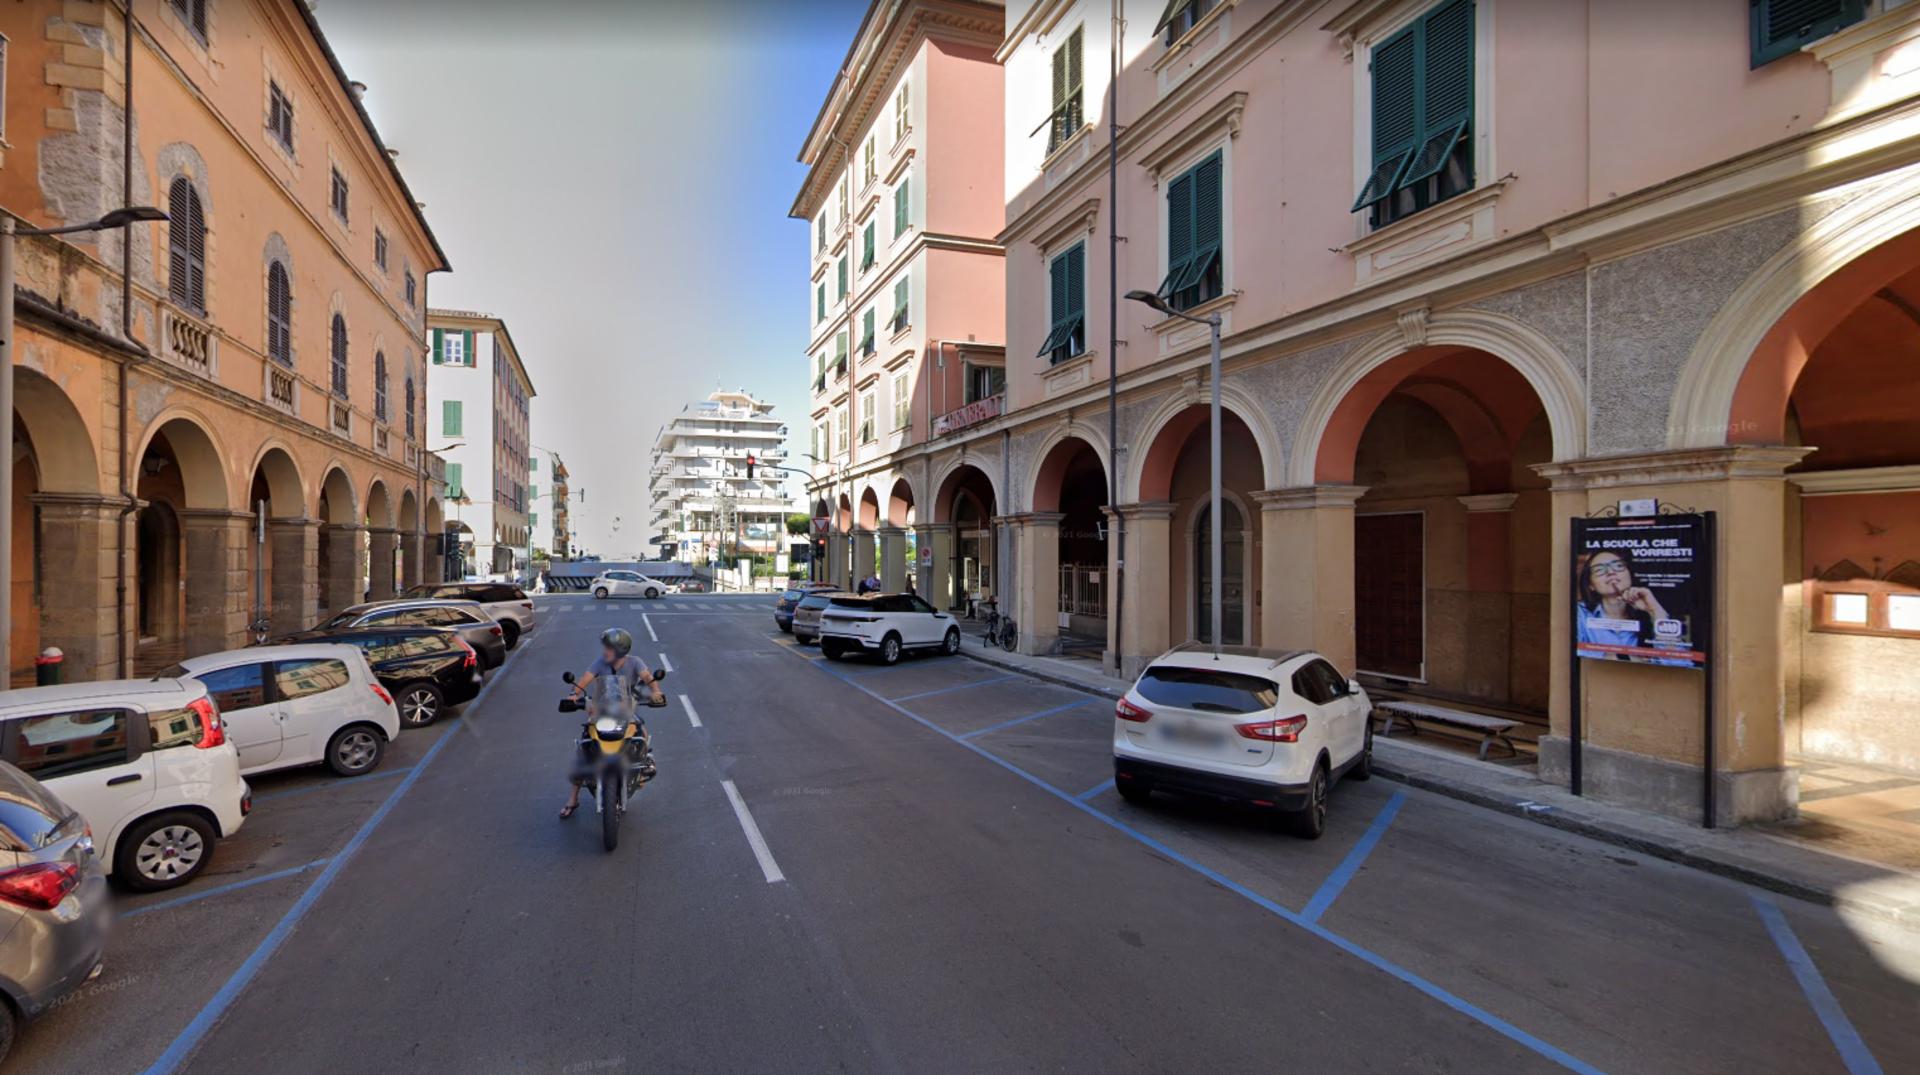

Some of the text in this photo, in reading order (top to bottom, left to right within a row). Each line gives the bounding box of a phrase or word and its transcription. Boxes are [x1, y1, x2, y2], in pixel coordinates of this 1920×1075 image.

[1586, 538, 1679, 548] LA SCUOLA CHE
[1631, 548, 1693, 557] VORRESTI
